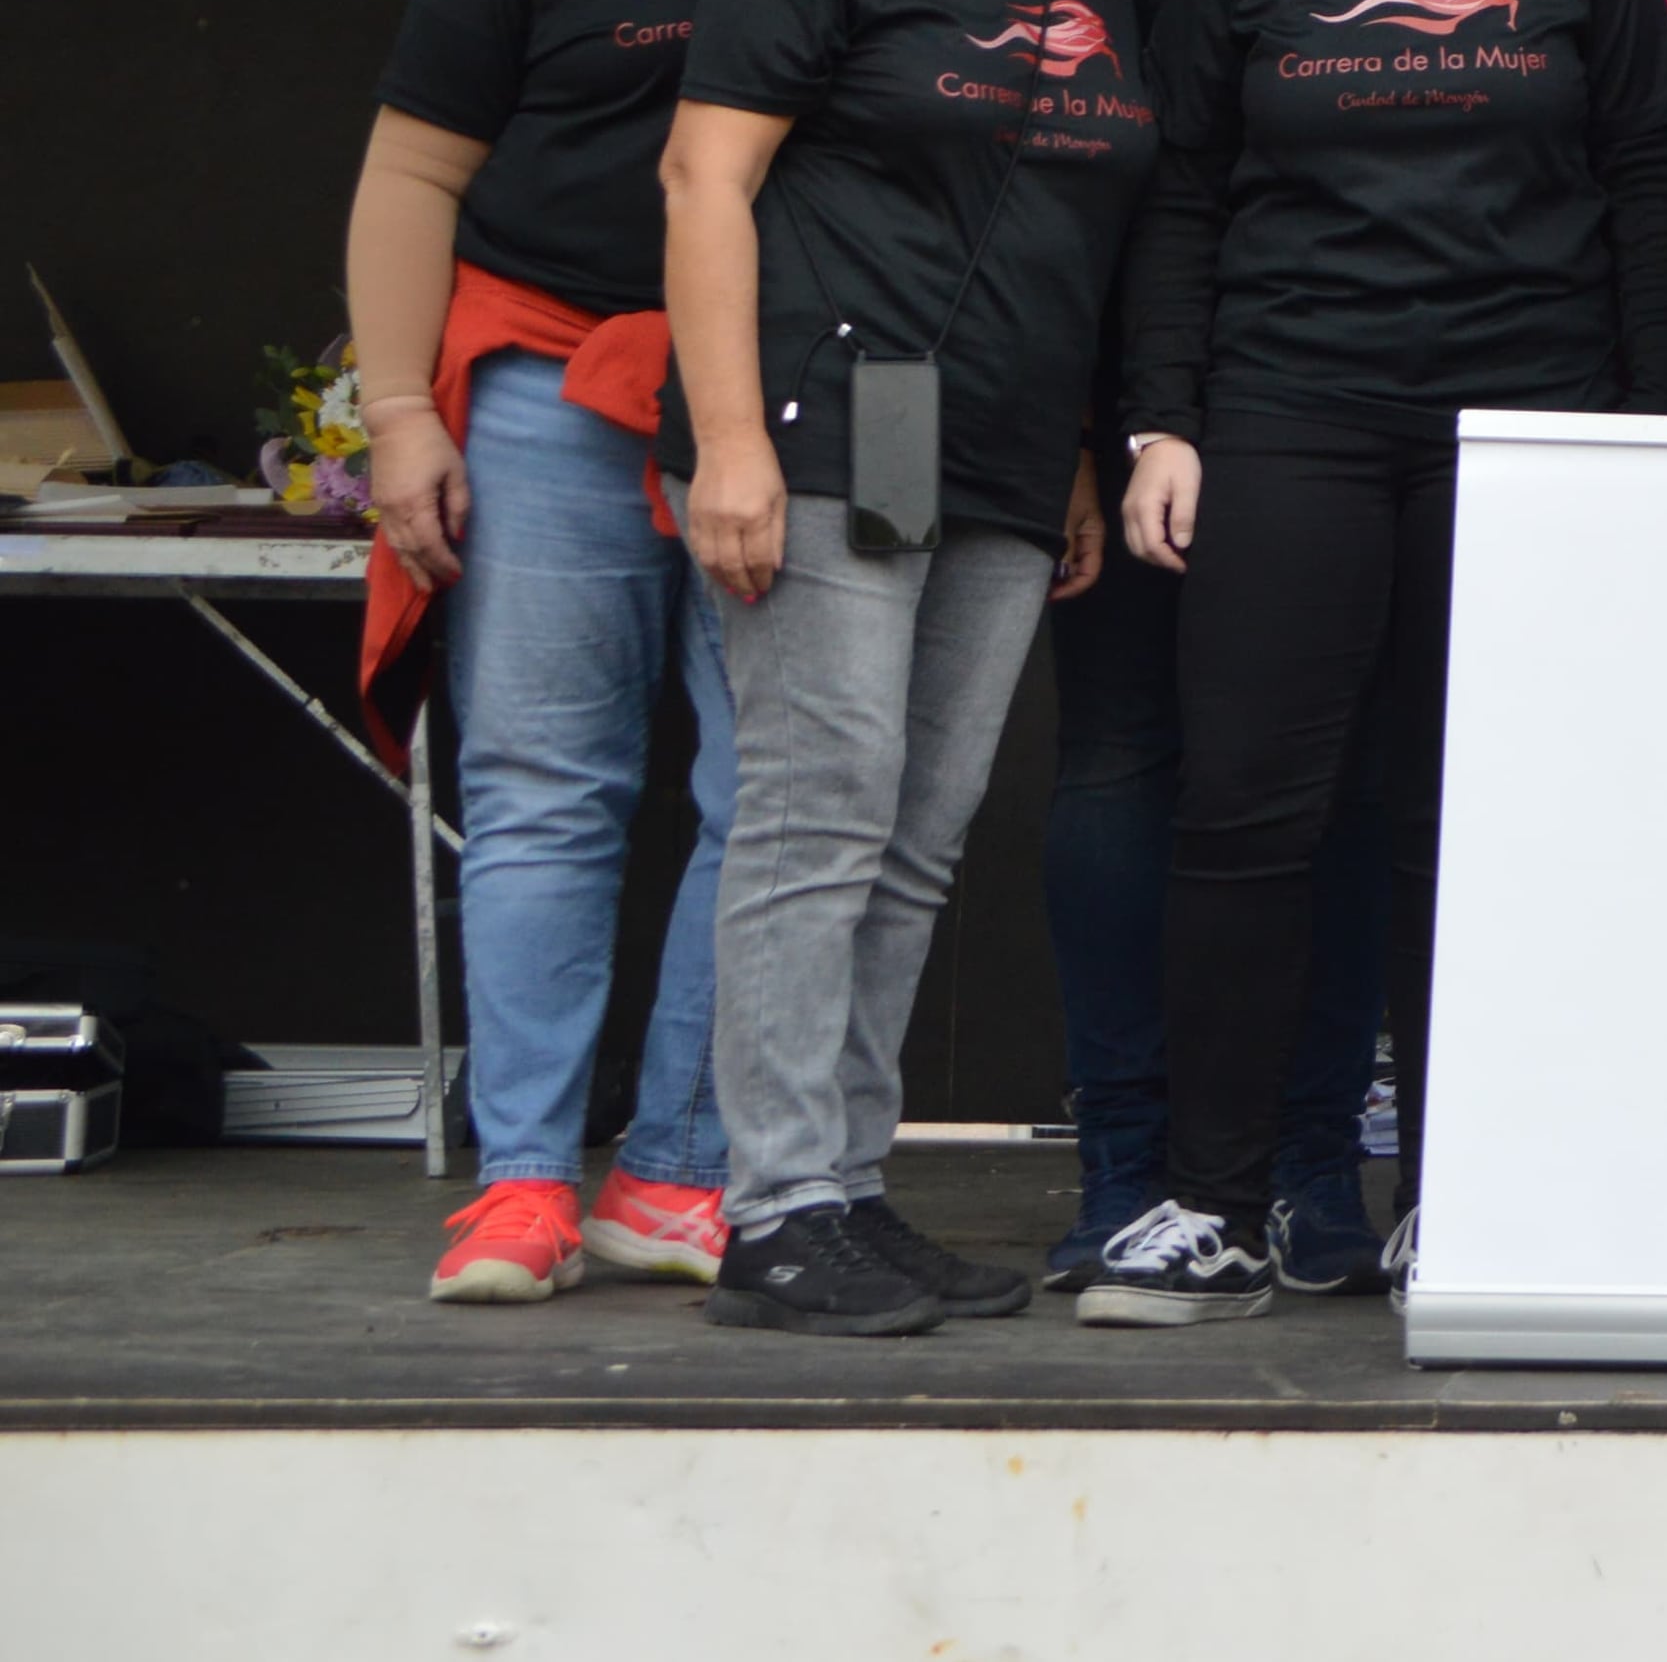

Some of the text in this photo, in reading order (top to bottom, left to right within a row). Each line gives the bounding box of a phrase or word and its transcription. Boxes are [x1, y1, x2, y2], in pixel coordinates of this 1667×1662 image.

[614, 21, 694, 48] Carre
[1278, 46, 1548, 78] Carrera de la Mujer
[1031, 95, 1054, 113] e
[1063, 89, 1087, 116] la
[1096, 95, 1154, 127] Muje
[1337, 91, 1397, 111] Ciudad
[1402, 91, 1418, 106] de
